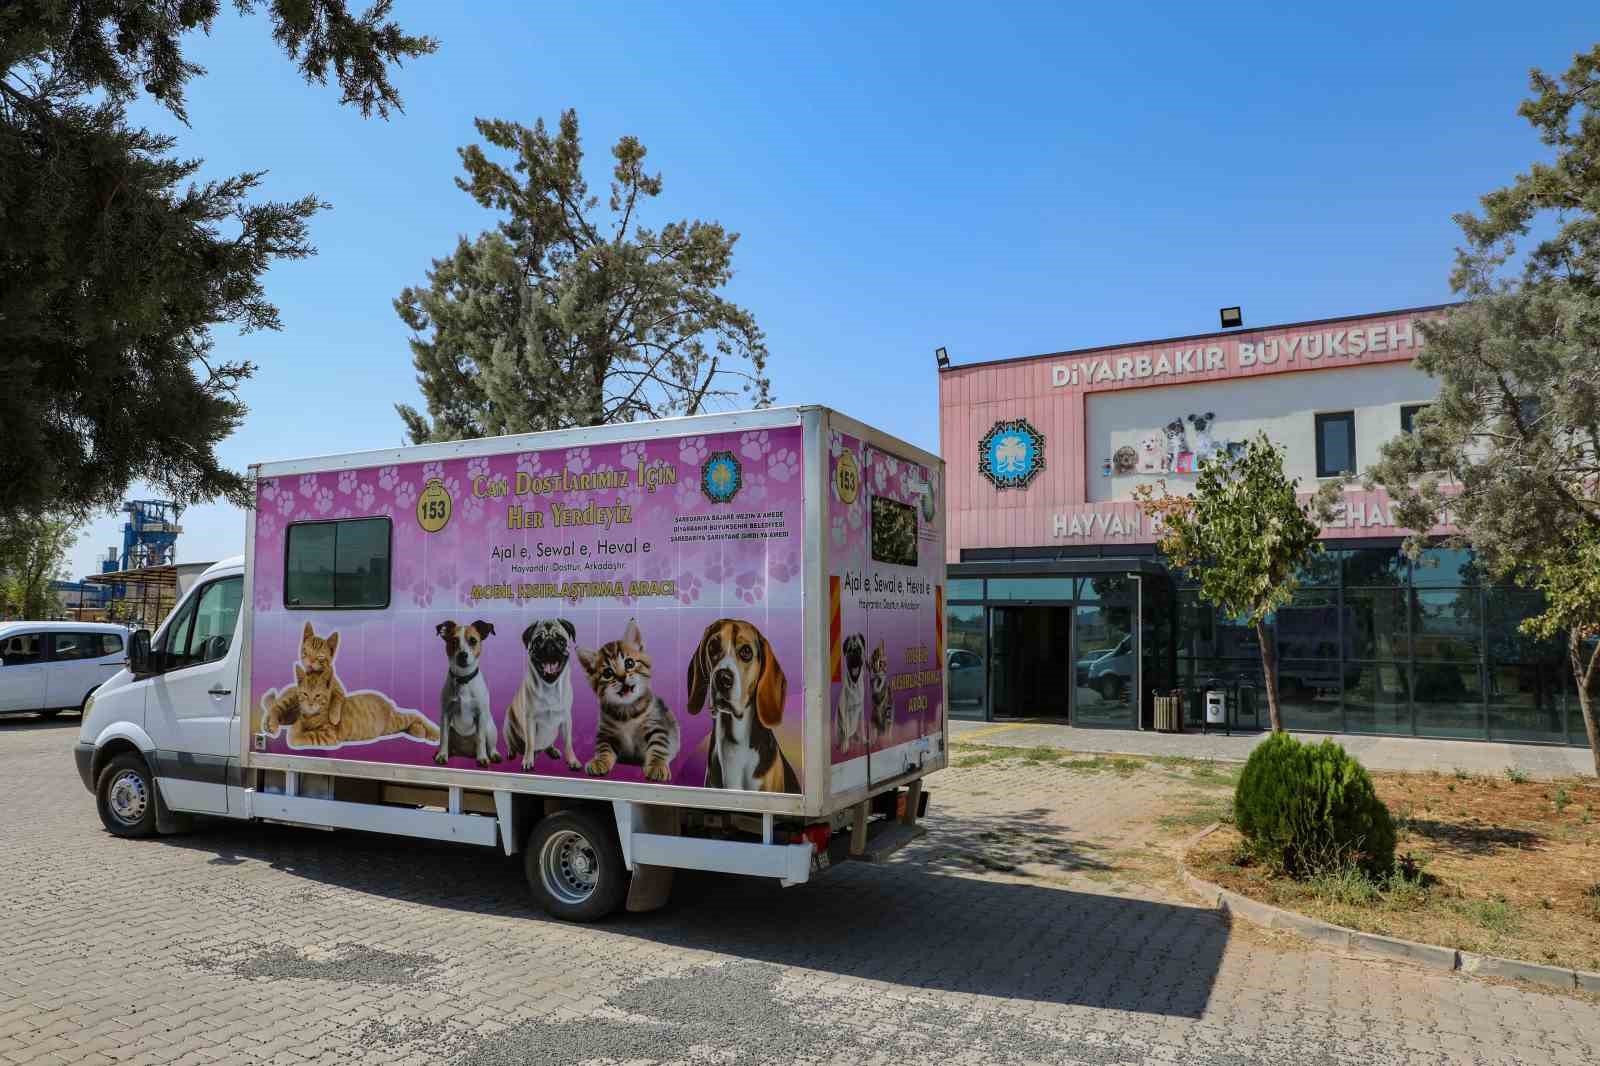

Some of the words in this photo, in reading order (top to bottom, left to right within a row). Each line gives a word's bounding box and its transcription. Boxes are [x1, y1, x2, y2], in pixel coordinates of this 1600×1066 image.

[839, 470, 856, 491] 153
[421, 500, 446, 520] 153
[491, 546, 516, 562] Ajal
[536, 541, 575, 558] Sewal
[597, 537, 638, 555] Heval
